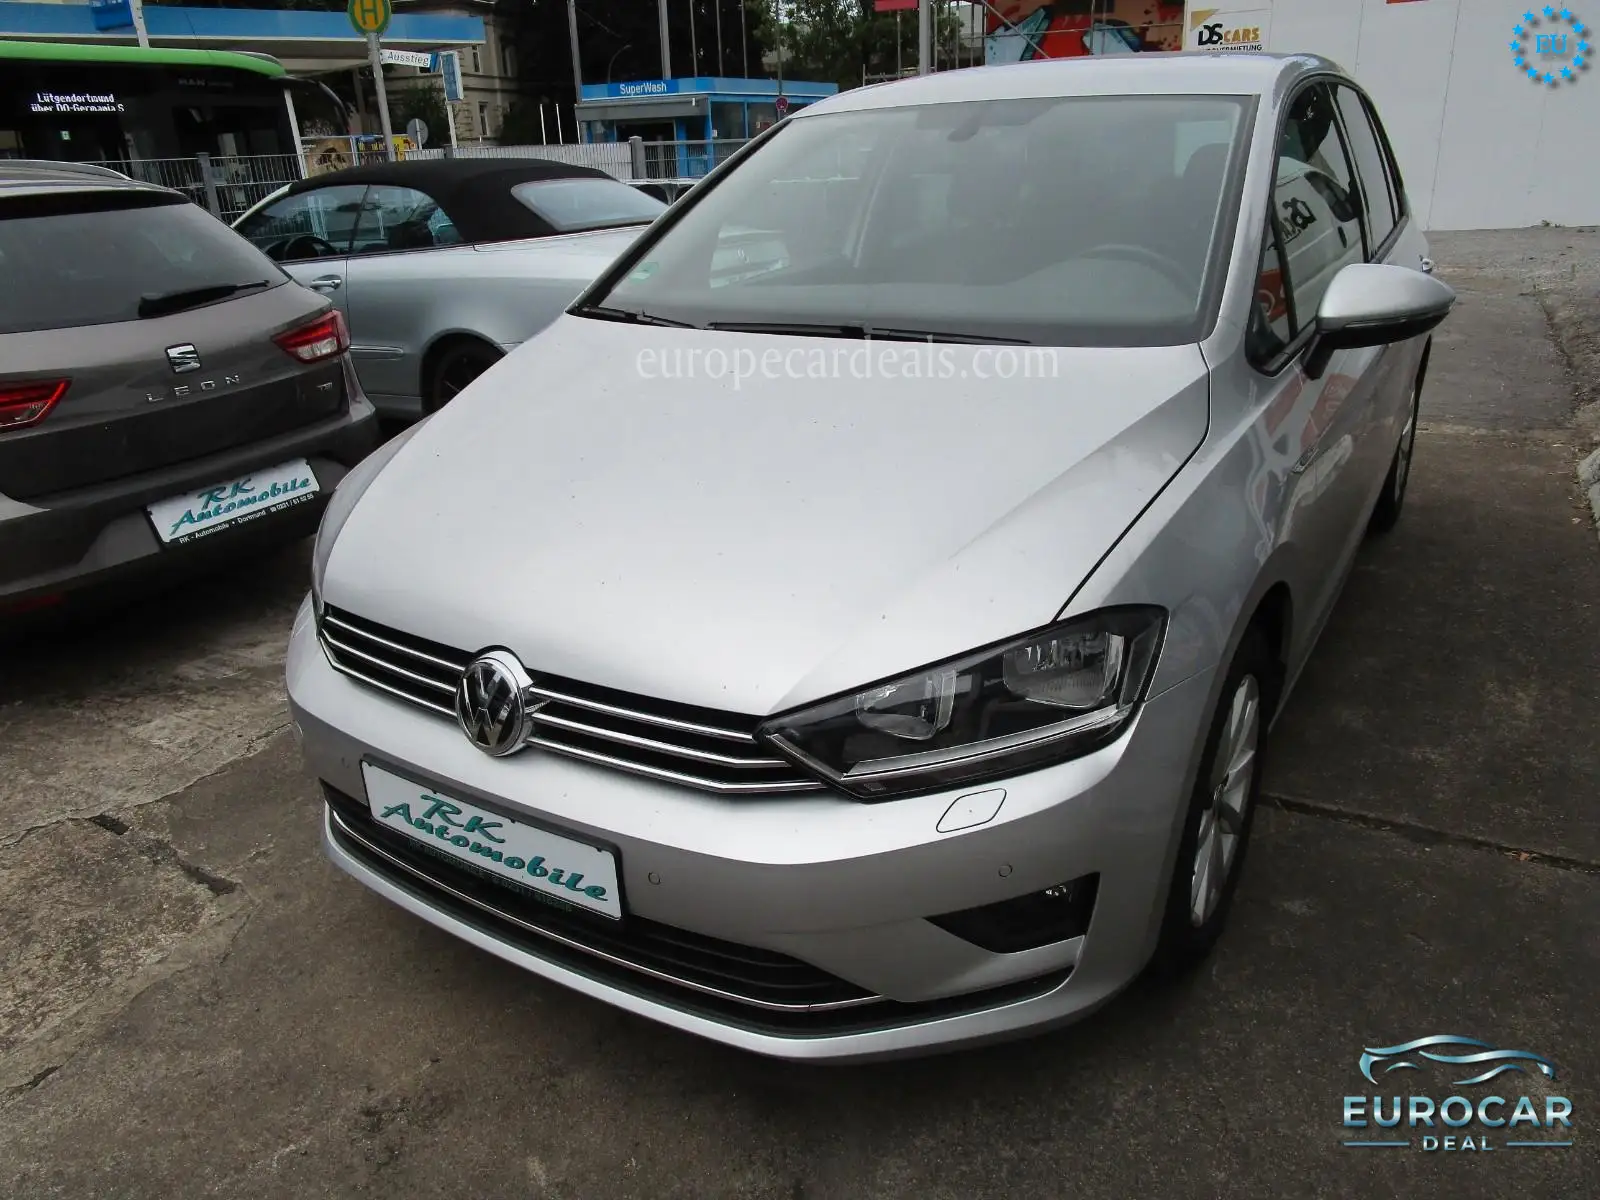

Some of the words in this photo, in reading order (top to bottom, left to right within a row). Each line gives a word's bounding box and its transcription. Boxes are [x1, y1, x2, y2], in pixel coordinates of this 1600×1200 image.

[387, 51, 429, 67] Ausstieg
[619, 82, 667, 96] SuperWash
[145, 374, 241, 403] LEON
[169, 477, 312, 537] Automobile
[197, 478, 255, 510] RK
[179, 535, 191, 544] RK
[195, 522, 230, 539] Automobile
[237, 509, 267, 524] Dortmund
[420, 794, 506, 844] RK
[380, 803, 608, 902] Automobile
